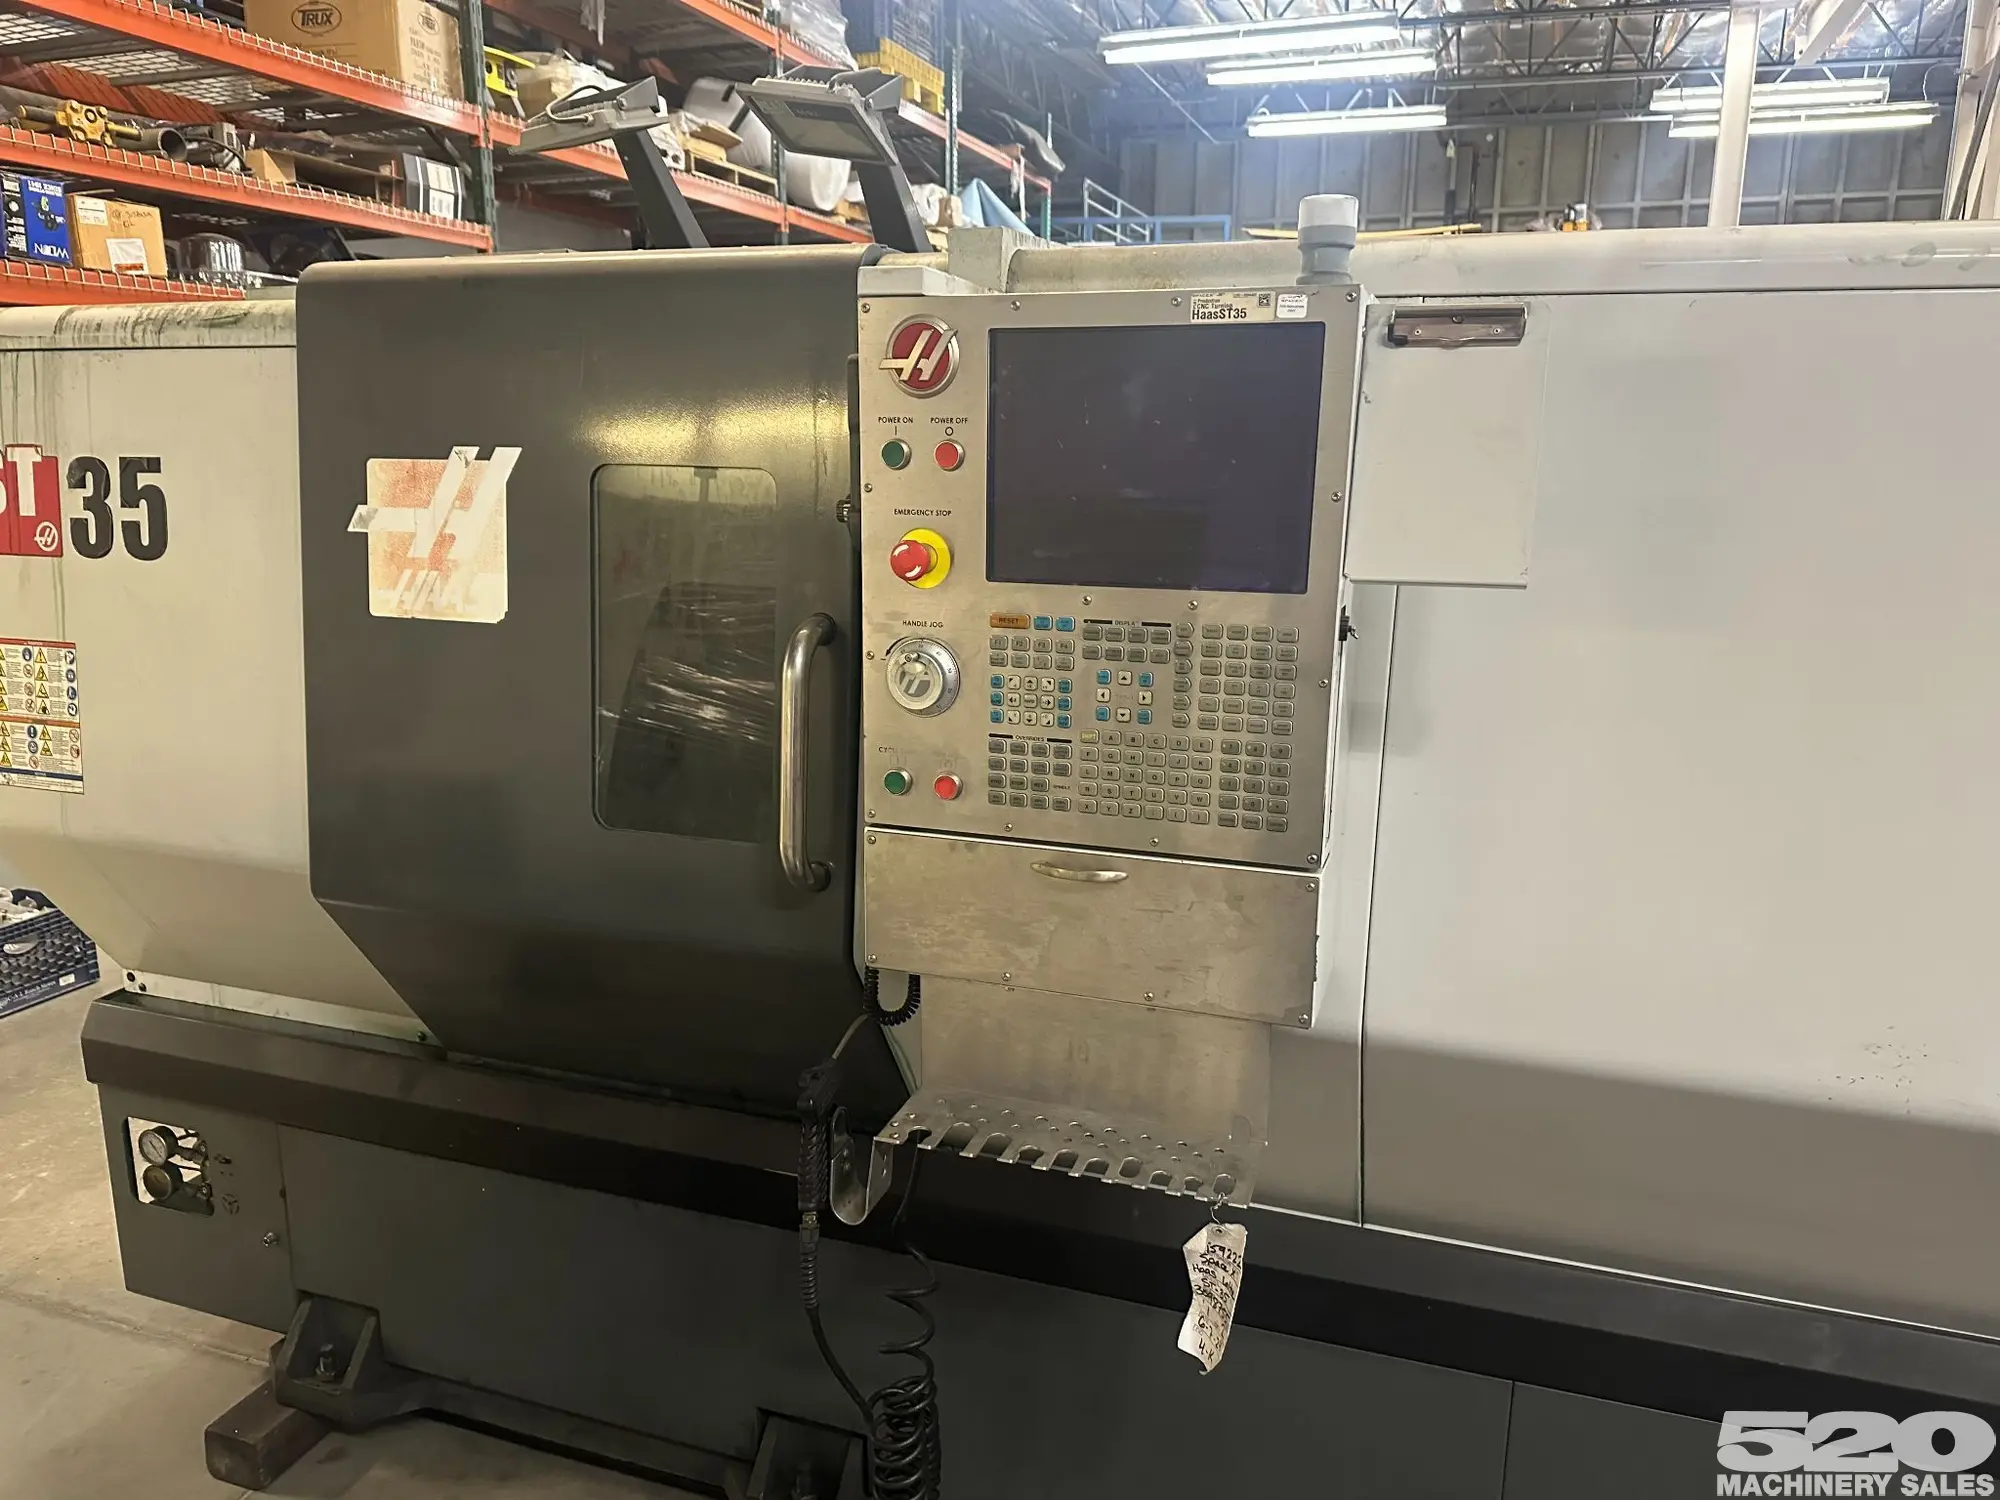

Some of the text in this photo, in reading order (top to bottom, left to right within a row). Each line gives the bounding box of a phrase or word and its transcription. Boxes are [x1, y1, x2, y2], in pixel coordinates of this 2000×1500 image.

[298, 8, 333, 26] TRUX
[1192, 308, 1247, 320] HaasST35
[0, 447, 168, 561] T 35
[902, 620, 928, 628] HANDLE
